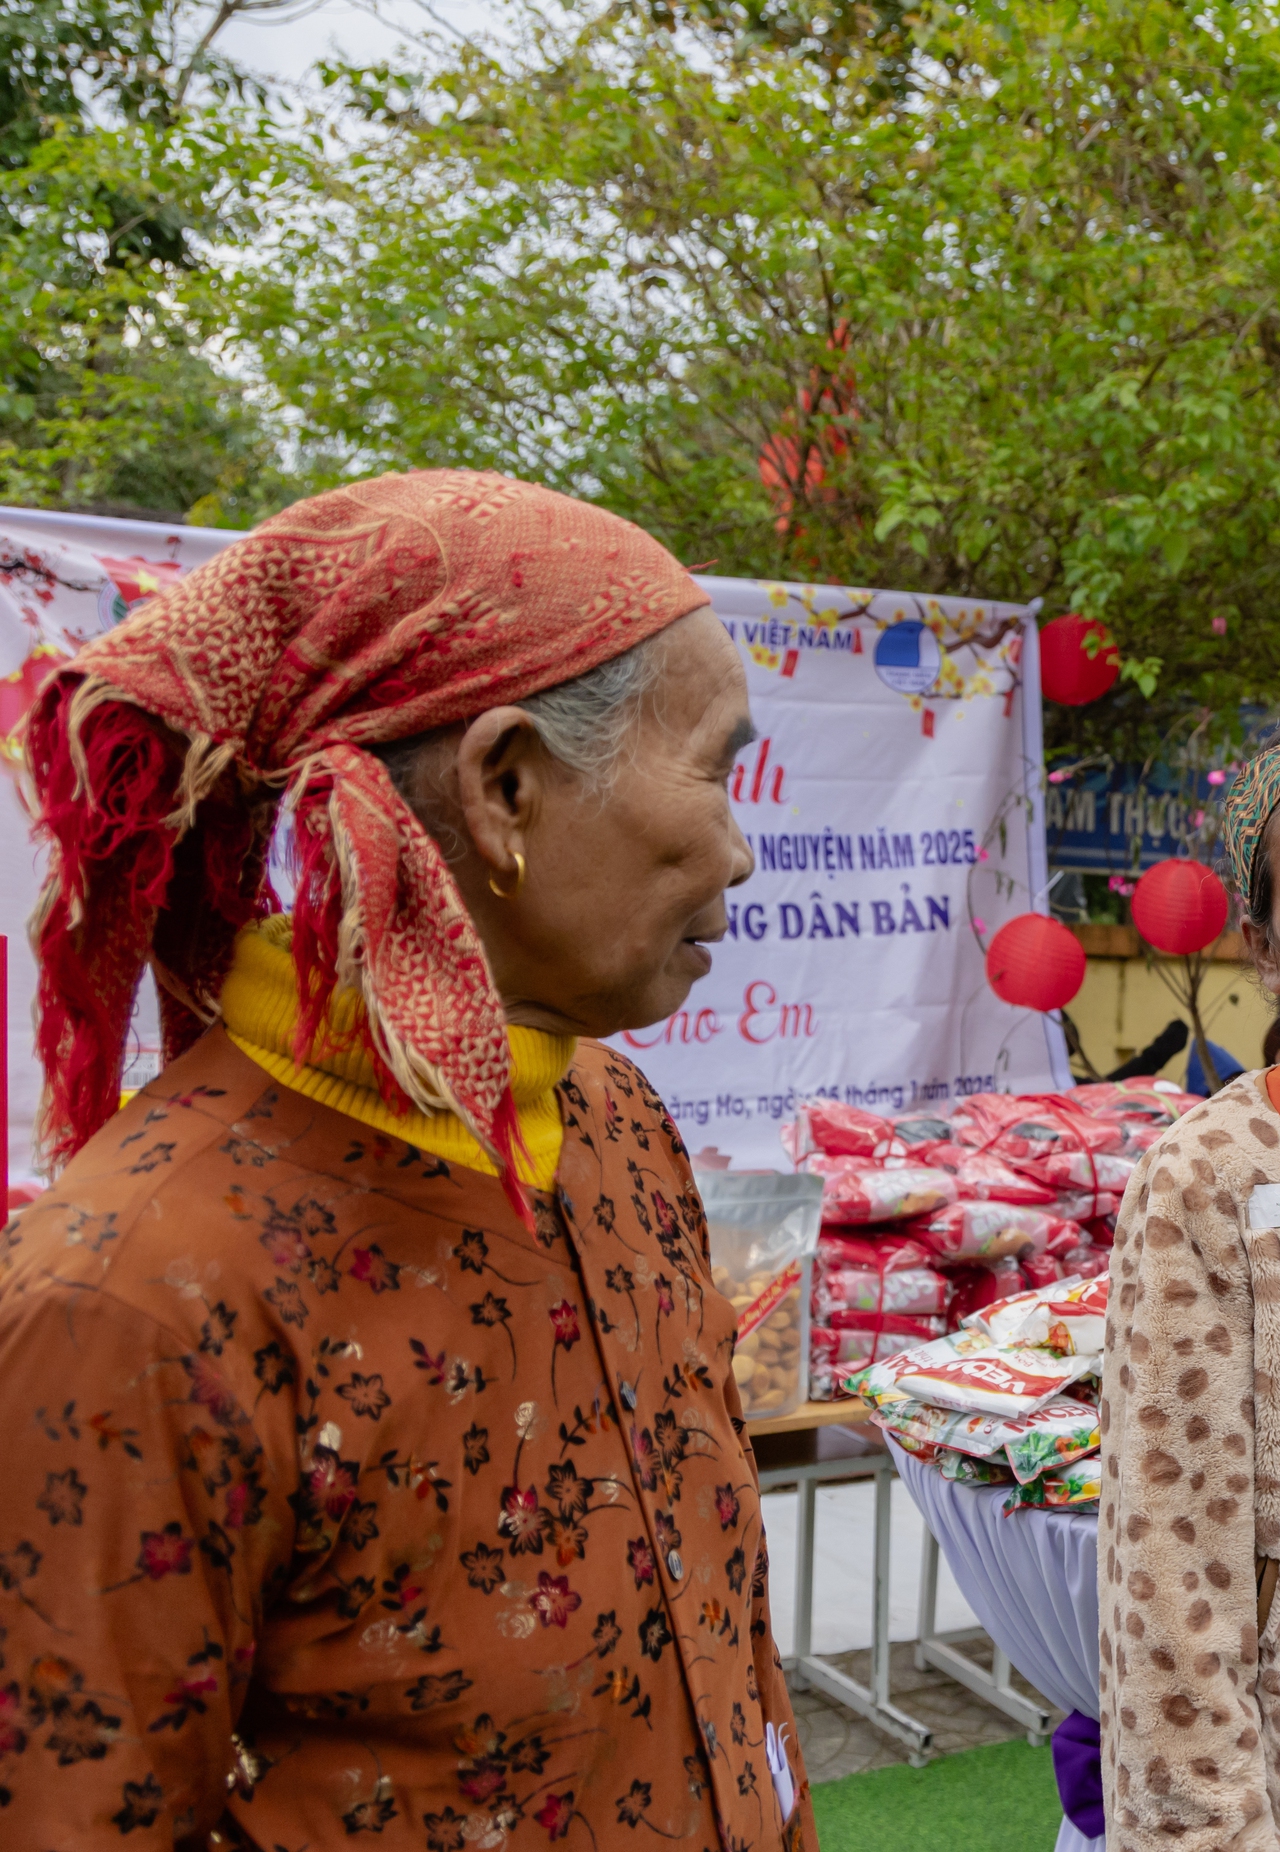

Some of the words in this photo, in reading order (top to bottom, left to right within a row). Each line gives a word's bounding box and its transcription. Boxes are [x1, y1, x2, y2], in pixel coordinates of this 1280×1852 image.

[743, 618, 791, 652] VIỆT
[798, 626, 852, 651] NAM
[759, 825, 853, 880] NGUYỆN
[858, 825, 915, 870] NĂM
[920, 828, 977, 866] 2025
[778, 889, 860, 940] DÂN
[870, 882, 950, 936] BẢN
[738, 980, 820, 1046] Em
[844, 1081, 904, 1109] tháng
